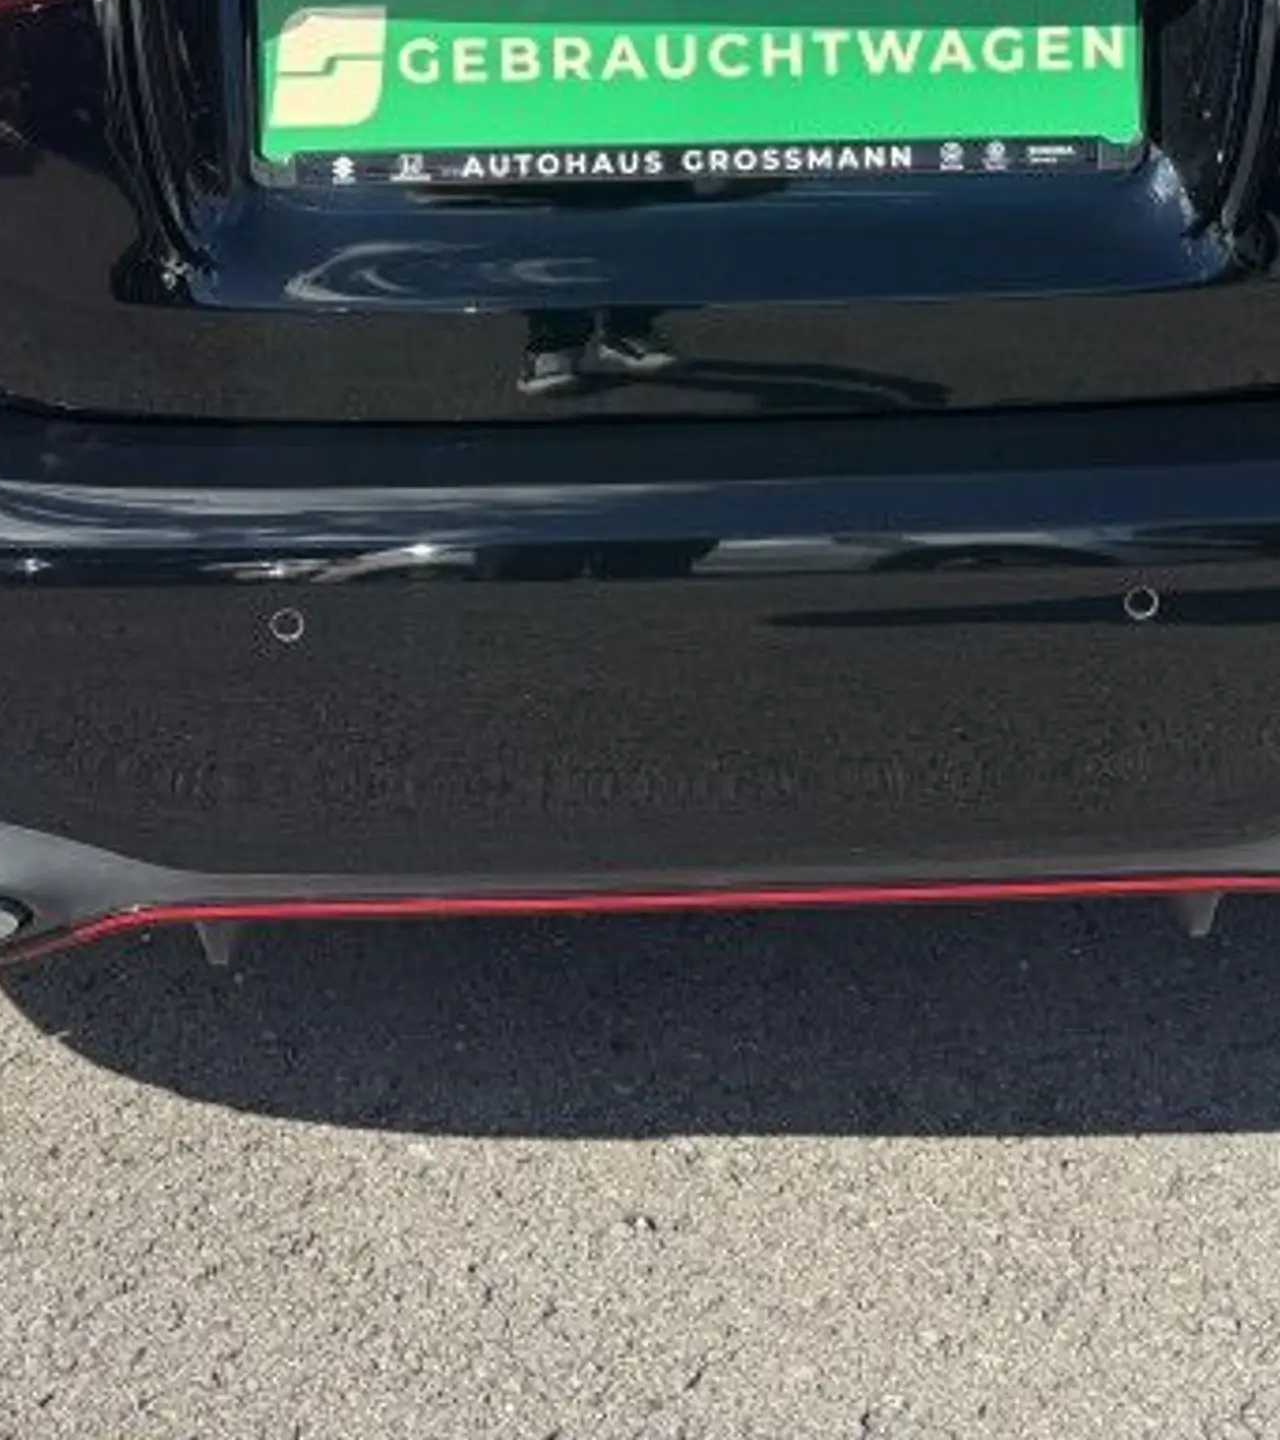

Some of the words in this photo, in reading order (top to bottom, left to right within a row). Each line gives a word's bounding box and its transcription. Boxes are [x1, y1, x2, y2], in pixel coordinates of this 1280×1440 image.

[398, 25, 1125, 84] GEBRAUCHTWAGEN
[462, 150, 664, 178] AUTOHAUS
[683, 145, 913, 173] GROSSMANN
